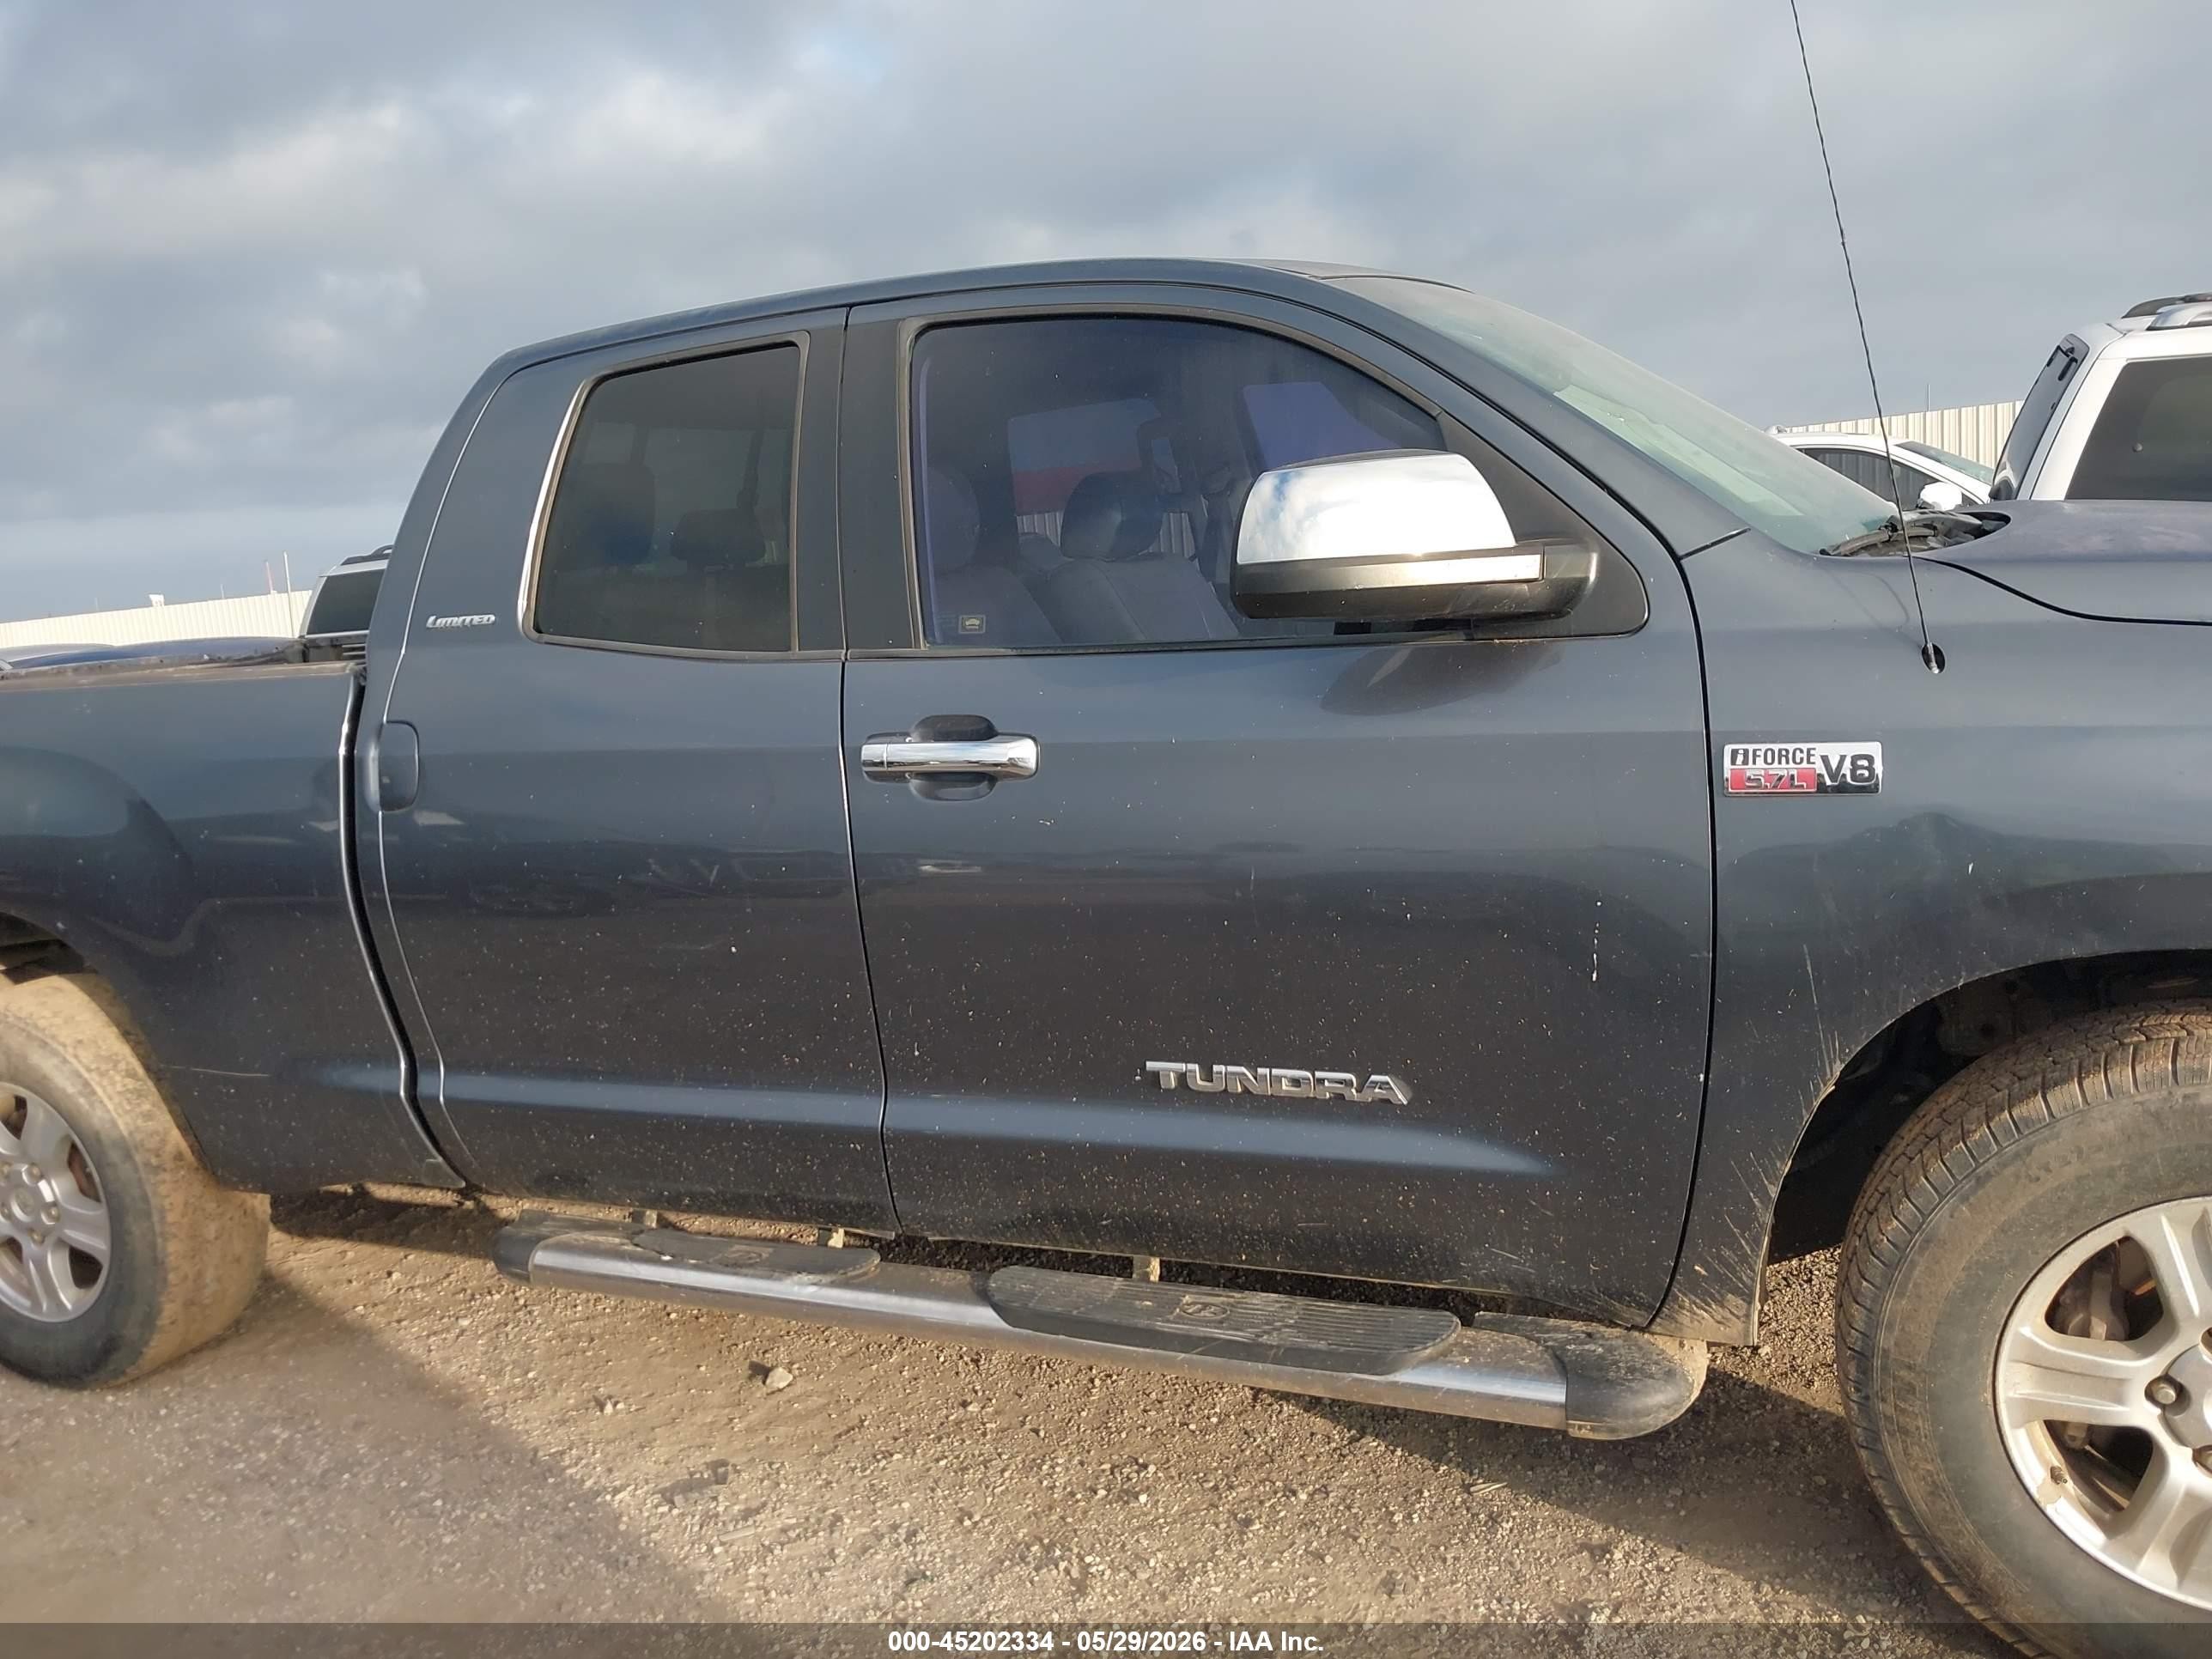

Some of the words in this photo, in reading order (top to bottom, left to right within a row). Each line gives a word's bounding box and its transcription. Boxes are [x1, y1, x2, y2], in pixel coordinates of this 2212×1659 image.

[1744, 768, 1807, 789] 5.7L
[1820, 753, 1875, 785] V8
[1146, 1060, 1408, 1105] TUNDRA
